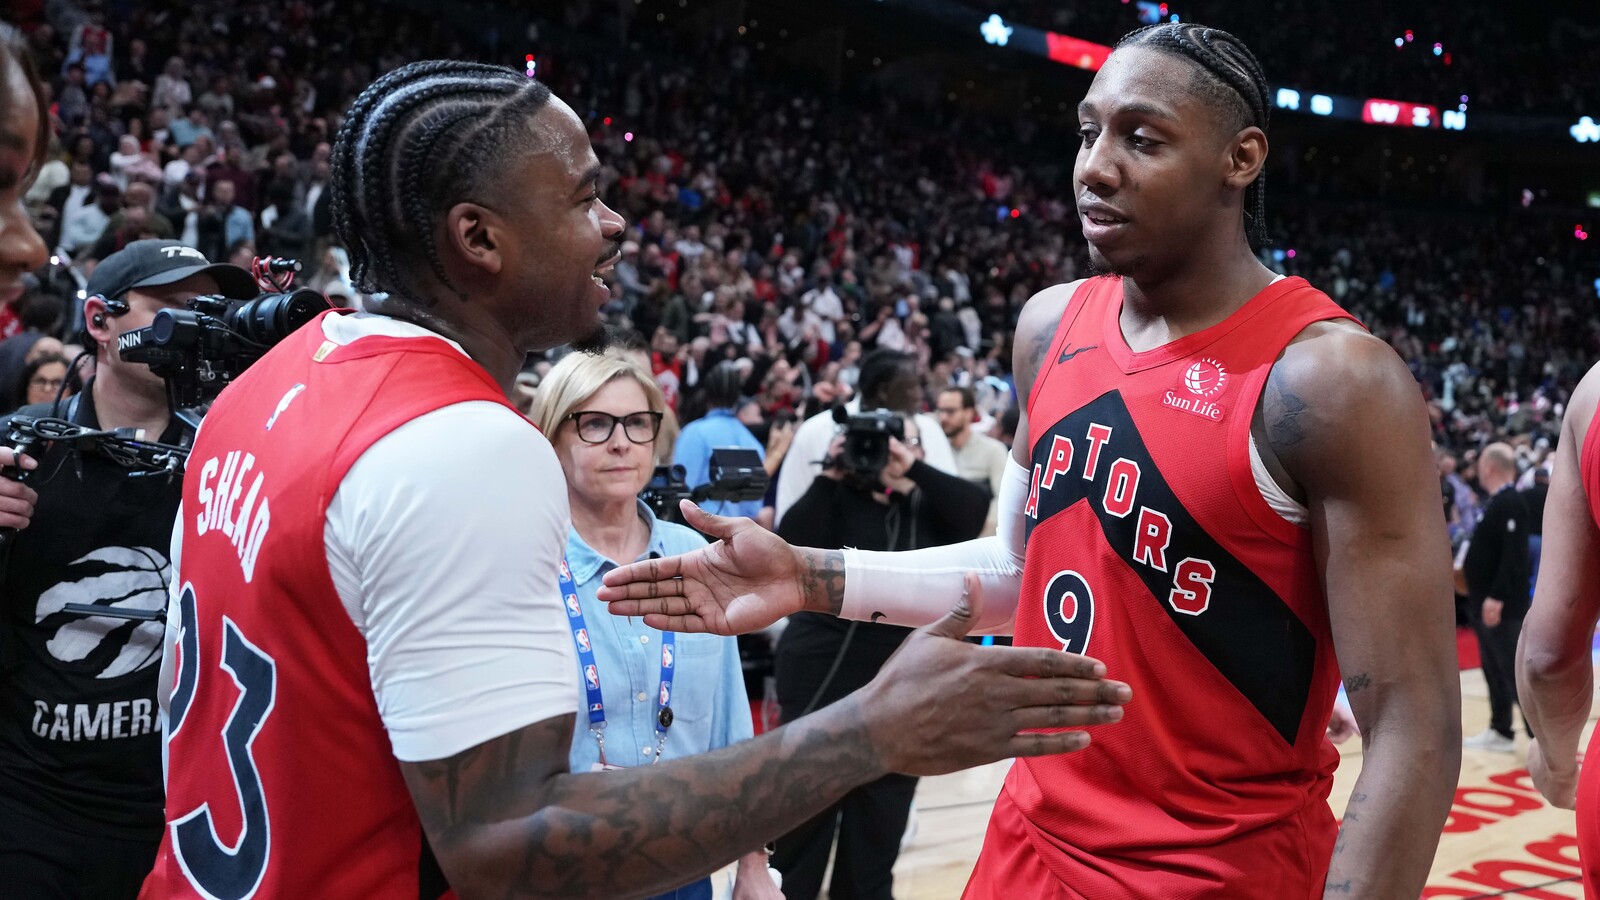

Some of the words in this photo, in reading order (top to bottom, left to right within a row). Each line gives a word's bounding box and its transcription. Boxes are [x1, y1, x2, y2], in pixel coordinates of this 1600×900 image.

[1163, 390, 1191, 411] Sun
[1191, 399, 1221, 419] Life
[197, 450, 270, 584] SHEAD
[1043, 569, 1095, 657] 9
